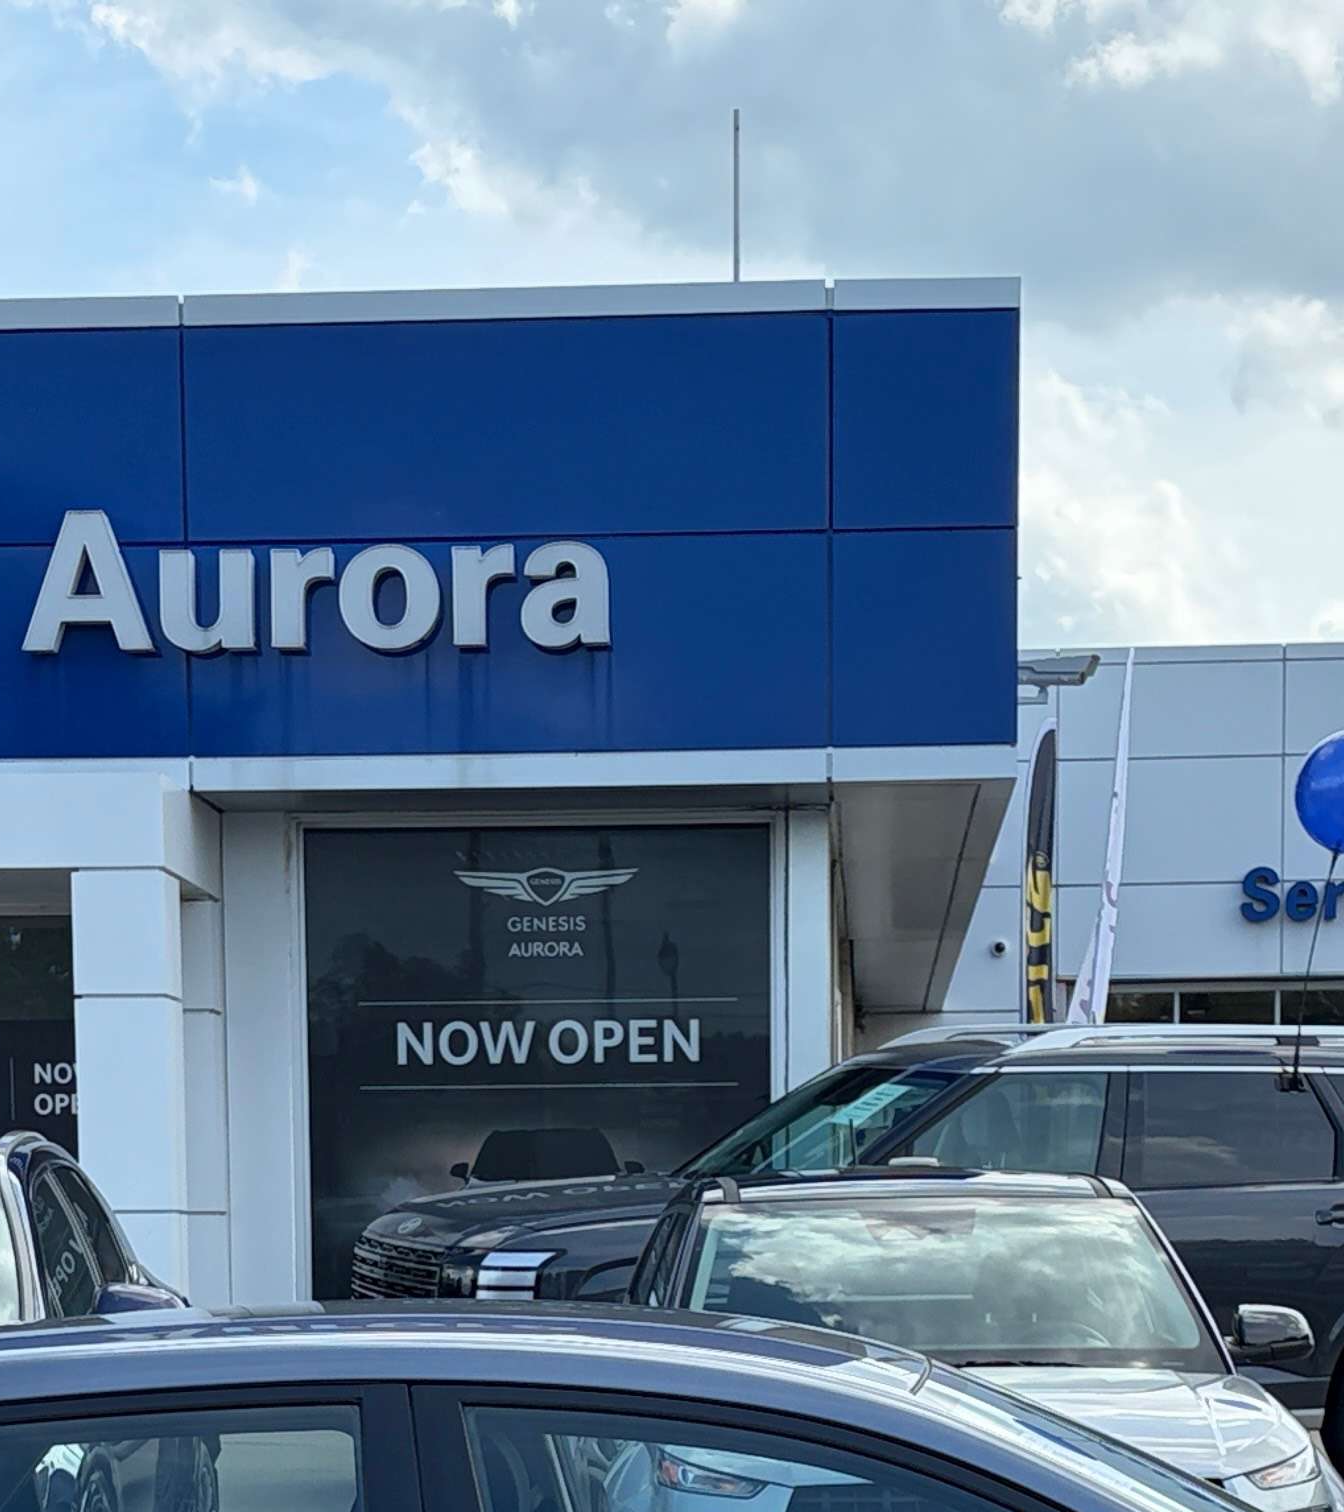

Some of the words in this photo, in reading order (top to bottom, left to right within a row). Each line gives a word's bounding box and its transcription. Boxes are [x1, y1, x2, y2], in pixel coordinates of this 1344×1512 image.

[22, 509, 611, 654] Aurora
[507, 915, 587, 932] GENESIS
[508, 941, 584, 958] AURORA
[396, 1020, 537, 1066] NOW
[548, 1018, 701, 1065] OPEN
[33, 1062, 78, 1085] NO
